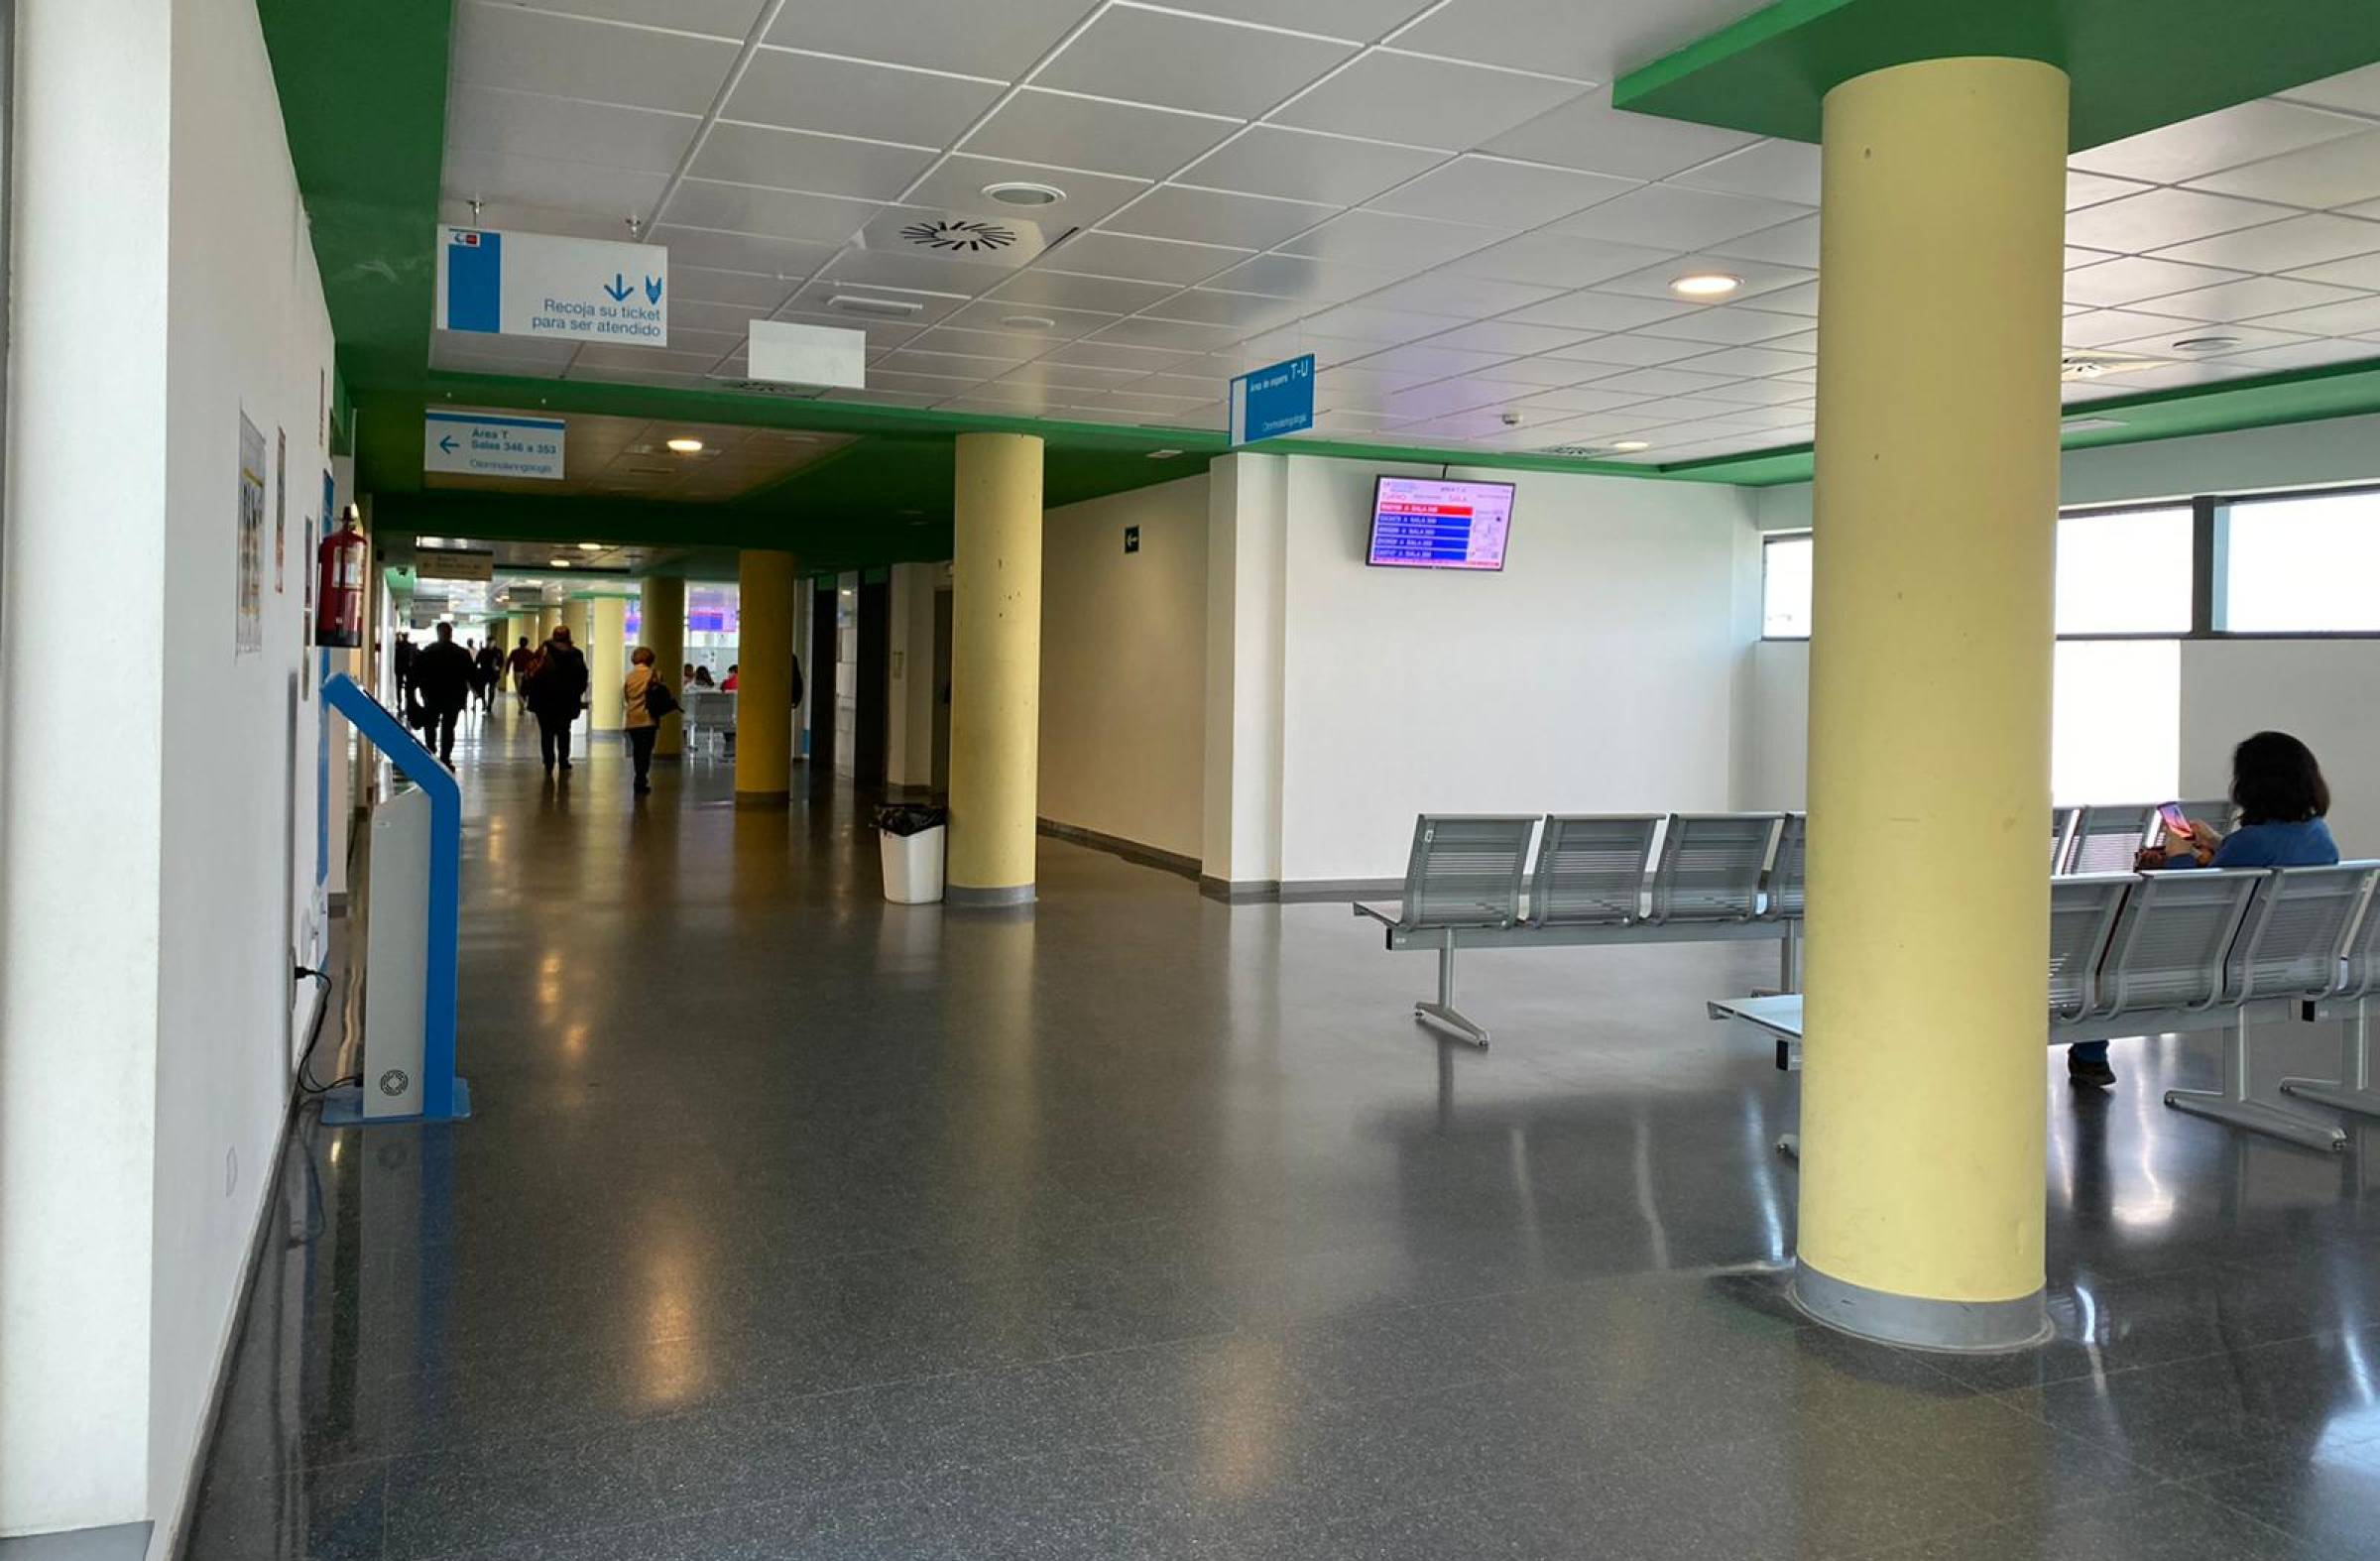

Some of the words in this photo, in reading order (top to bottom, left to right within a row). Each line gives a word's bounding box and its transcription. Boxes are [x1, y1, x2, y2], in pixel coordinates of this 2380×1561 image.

[544, 299, 595, 317] Recoja
[599, 306, 617, 317] su
[622, 305, 660, 321] ticket
[532, 316, 566, 330] para
[570, 319, 594, 331] ser
[597, 320, 661, 336] atendido
